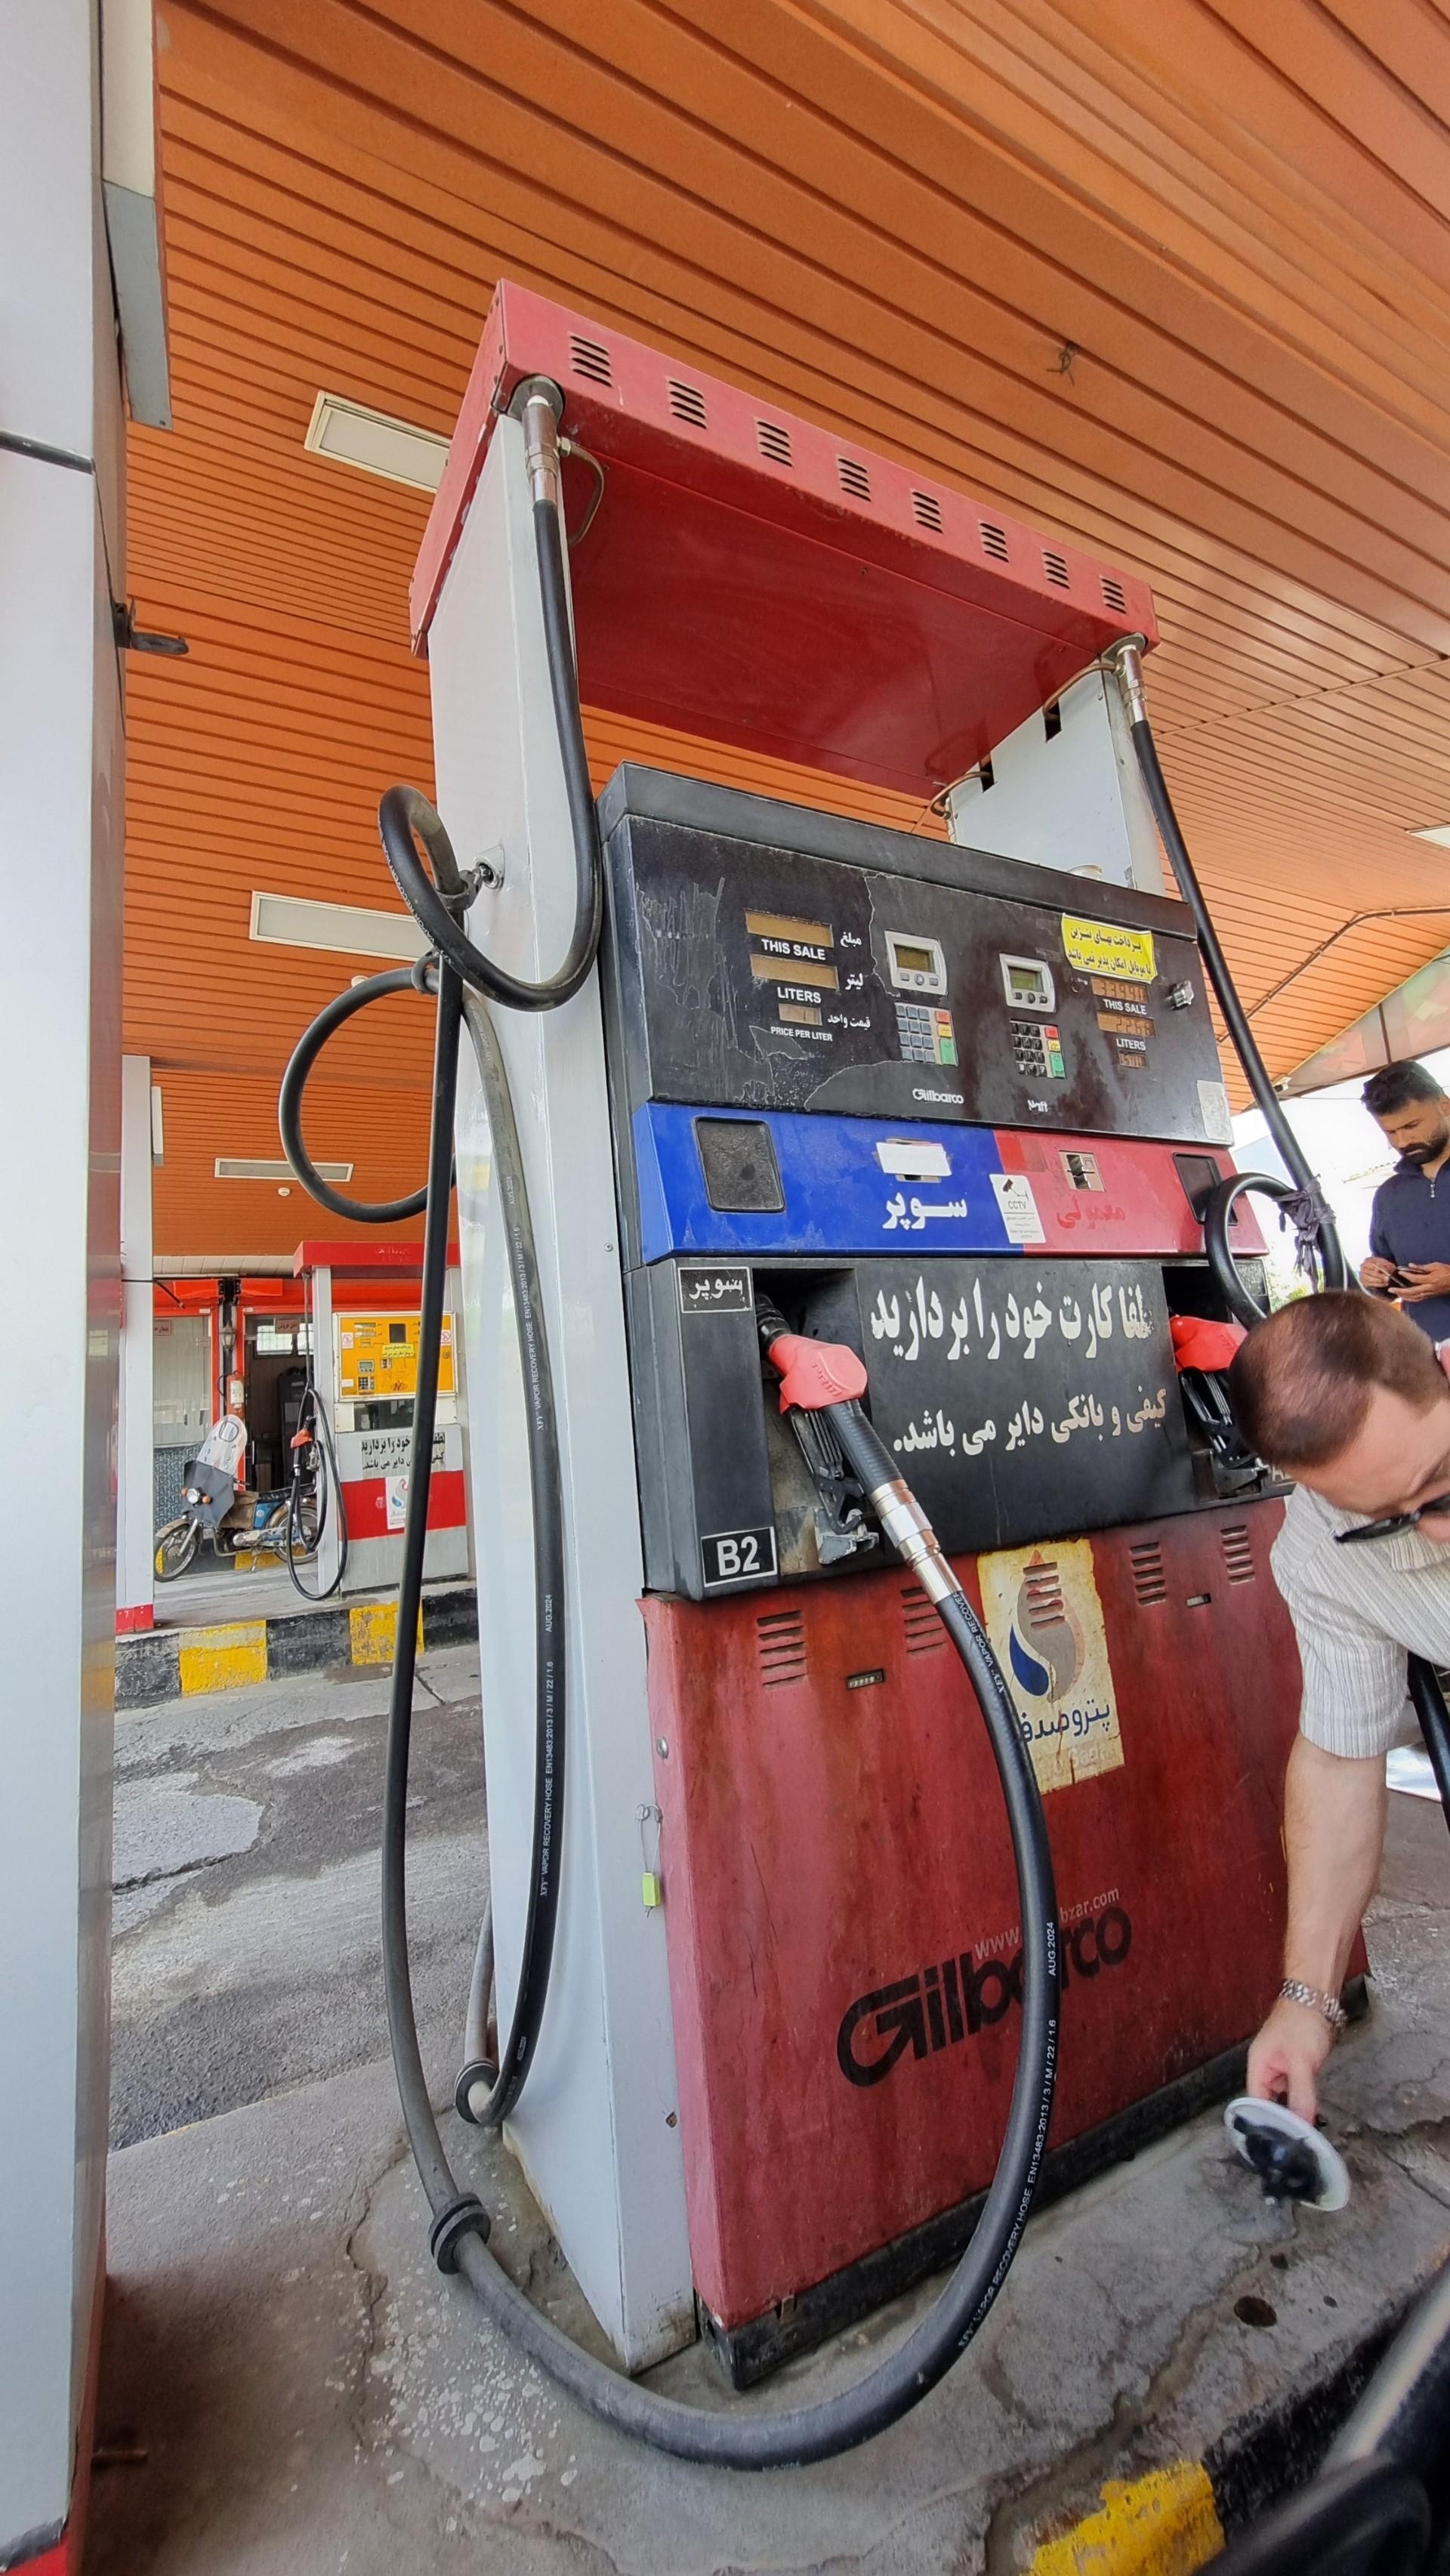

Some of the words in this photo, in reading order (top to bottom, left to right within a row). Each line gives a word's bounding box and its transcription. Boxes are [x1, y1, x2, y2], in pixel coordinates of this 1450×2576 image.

[761, 939, 791, 954] THIS
[793, 944, 826, 961] SALE
[840, 931, 862, 947] مبلغ
[777, 987, 822, 1004] LITERS
[1103, 999, 1124, 1011] THIS
[1125, 1003, 1147, 1015] SALE
[770, 1026, 794, 1037] PRICE
[794, 1030, 811, 1039] PER
[812, 1032, 833, 1042] LITER
[828, 1014, 848, 1028] واحد
[850, 1016, 871, 1030] قیمت
[1116, 1038, 1146, 1051] LITERS
[912, 1088, 964, 1104] Gilbarco
[882, 1192, 967, 1231] سوپر
[1007, 1201, 1026, 1209] CCTV
[689, 1277, 743, 1300] سوپر
[871, 1275, 970, 1361] بردارید
[973, 1277, 1001, 1360] را
[1004, 1281, 1052, 1359] خود
[1060, 1282, 1113, 1358] کارت
[1118, 1283, 1154, 1339] طفا
[1005, 1401, 1044, 1451] دایر
[1051, 1394, 1104, 1442] بانکی
[1110, 1405, 1122, 1435] و
[1126, 1385, 1167, 1433] کیفی
[962, 1419, 996, 1456] می
[717, 1536, 760, 1576] B2
[975, 1634, 994, 1666] VAPOR
[543, 1802, 552, 1846] RECOVERY
[541, 1848, 550, 1875] VAPOR
[1046, 1921, 1057, 1976] AUG.2024
[992, 2222, 1020, 2285] RECOVERY
[1017, 2188, 1032, 2222] HOSE
